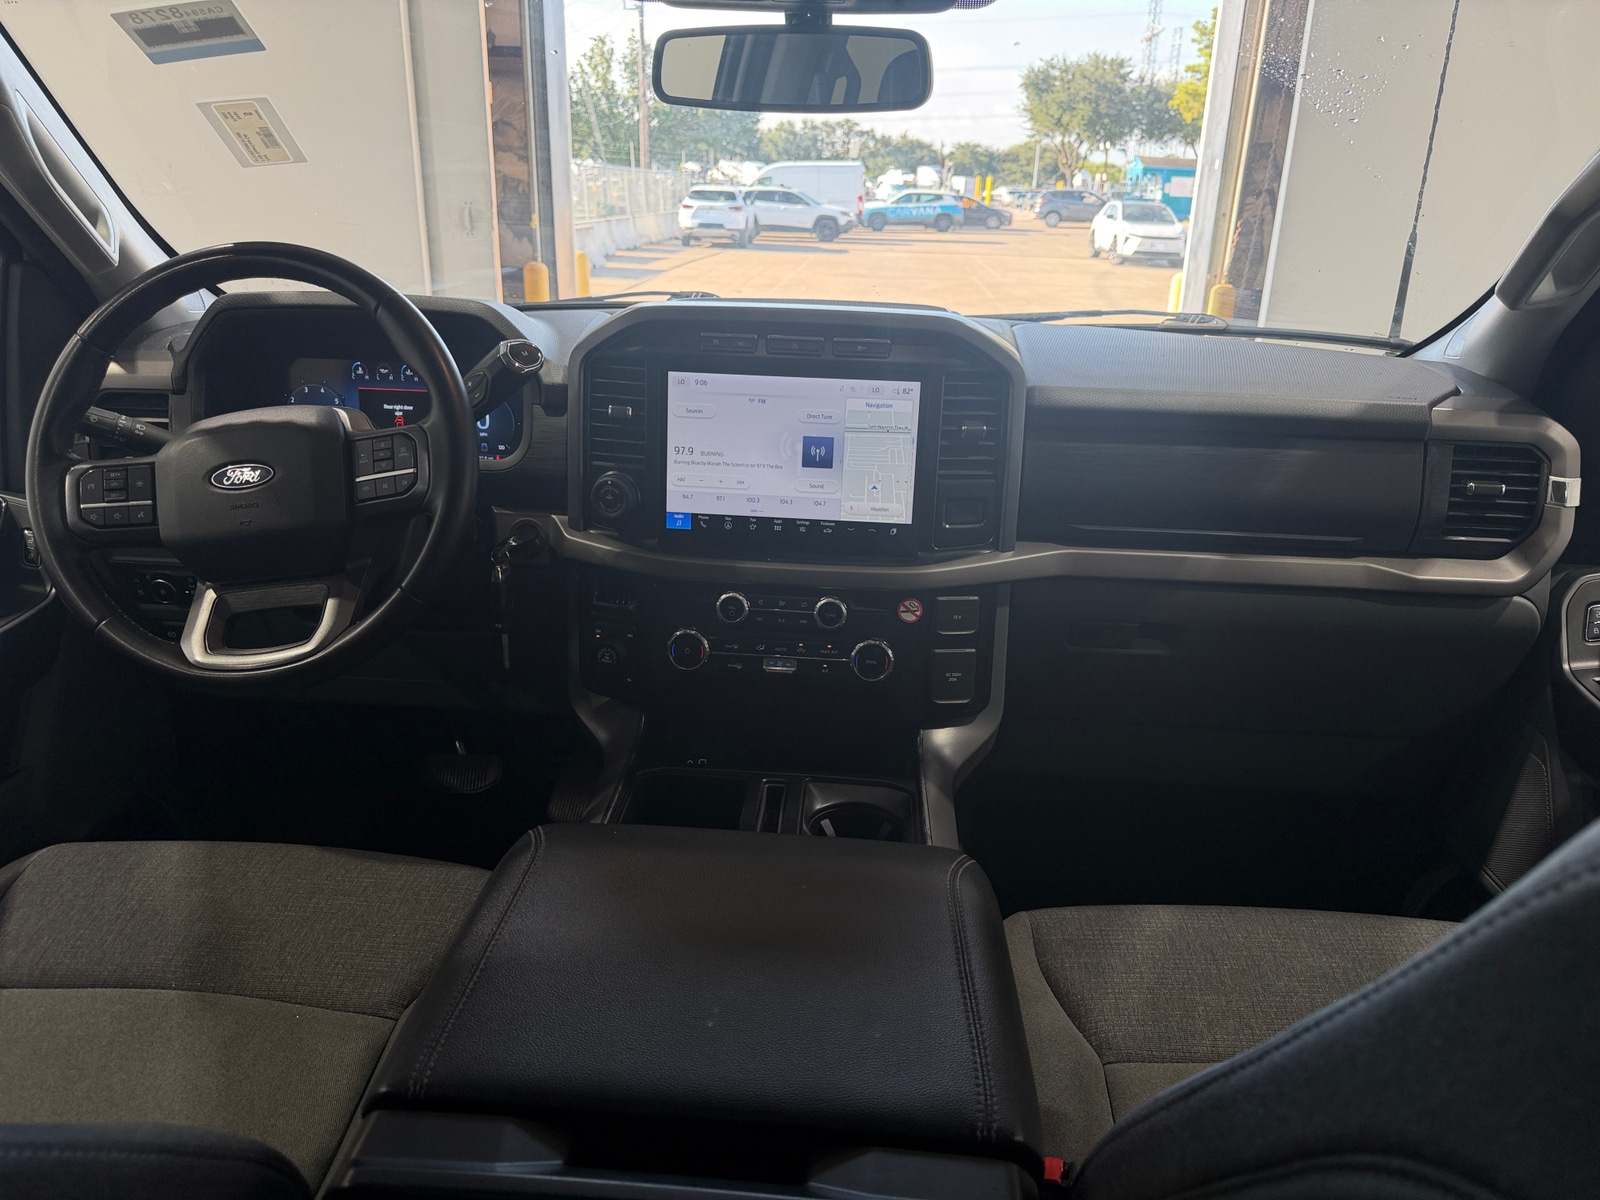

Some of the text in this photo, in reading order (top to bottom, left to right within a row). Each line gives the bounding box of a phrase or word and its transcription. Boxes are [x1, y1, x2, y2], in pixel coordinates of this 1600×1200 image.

[887, 205, 942, 217] CARVANA
[694, 379, 708, 387] 9:06
[872, 386, 880, 394] LO
[902, 388, 914, 396] 82°
[865, 402, 893, 410] Navigation
[821, 413, 833, 421] Tune
[674, 446, 723, 458] 97.9 BURNING
[673, 459, 690, 467] Burning
[223, 467, 261, 485] Ford
